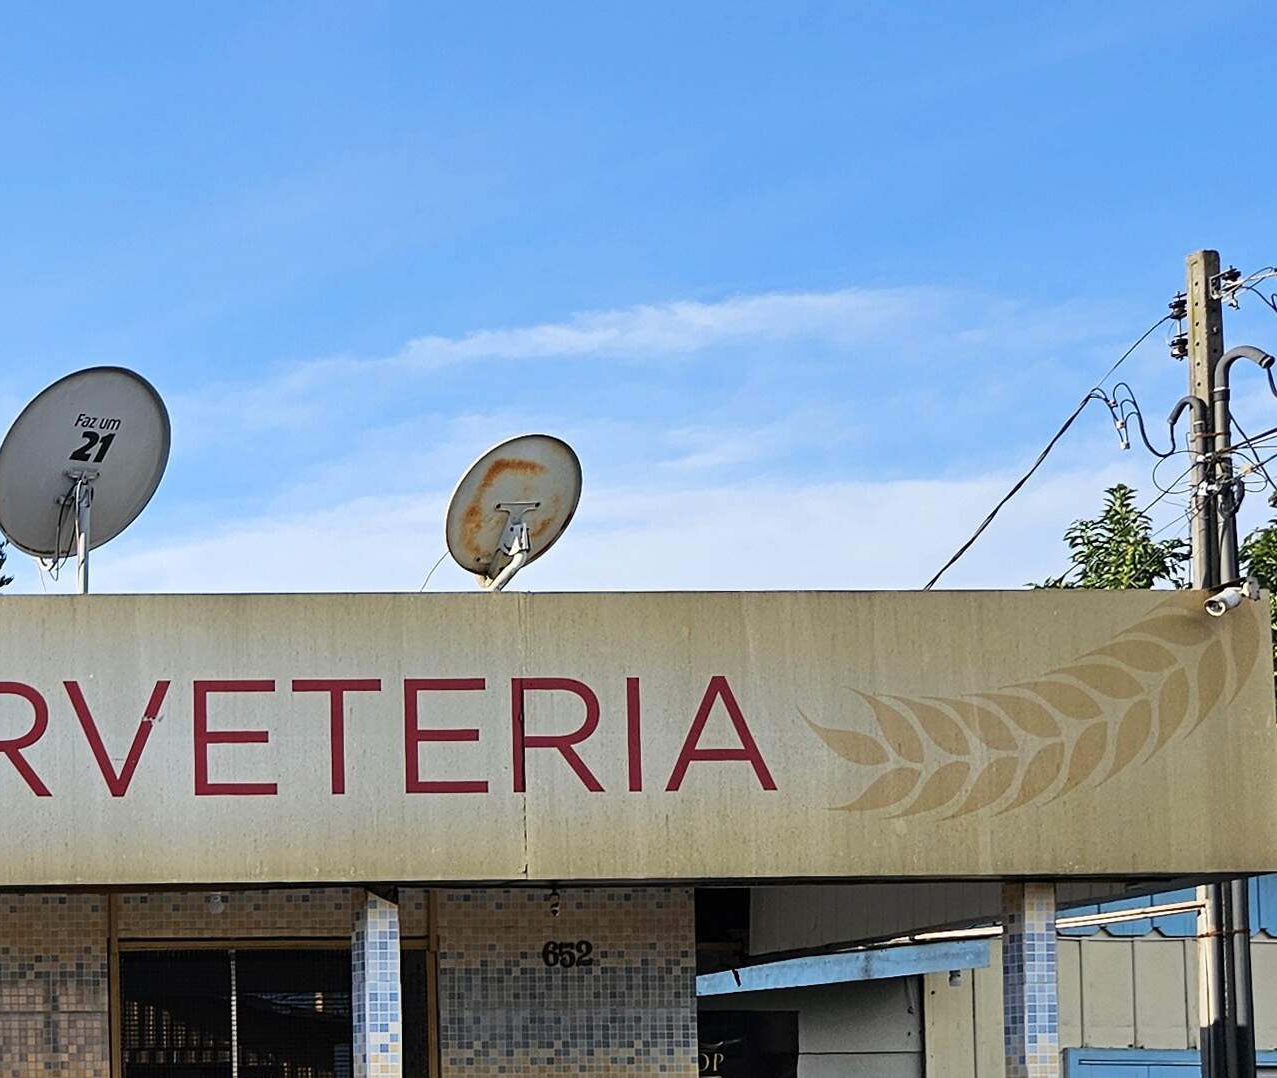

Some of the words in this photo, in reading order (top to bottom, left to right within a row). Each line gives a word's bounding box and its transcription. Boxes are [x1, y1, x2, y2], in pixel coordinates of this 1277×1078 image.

[74, 413, 98, 429] Faz
[99, 417, 122, 431] um
[69, 431, 116, 463] 21
[542, 940, 594, 968] 652
